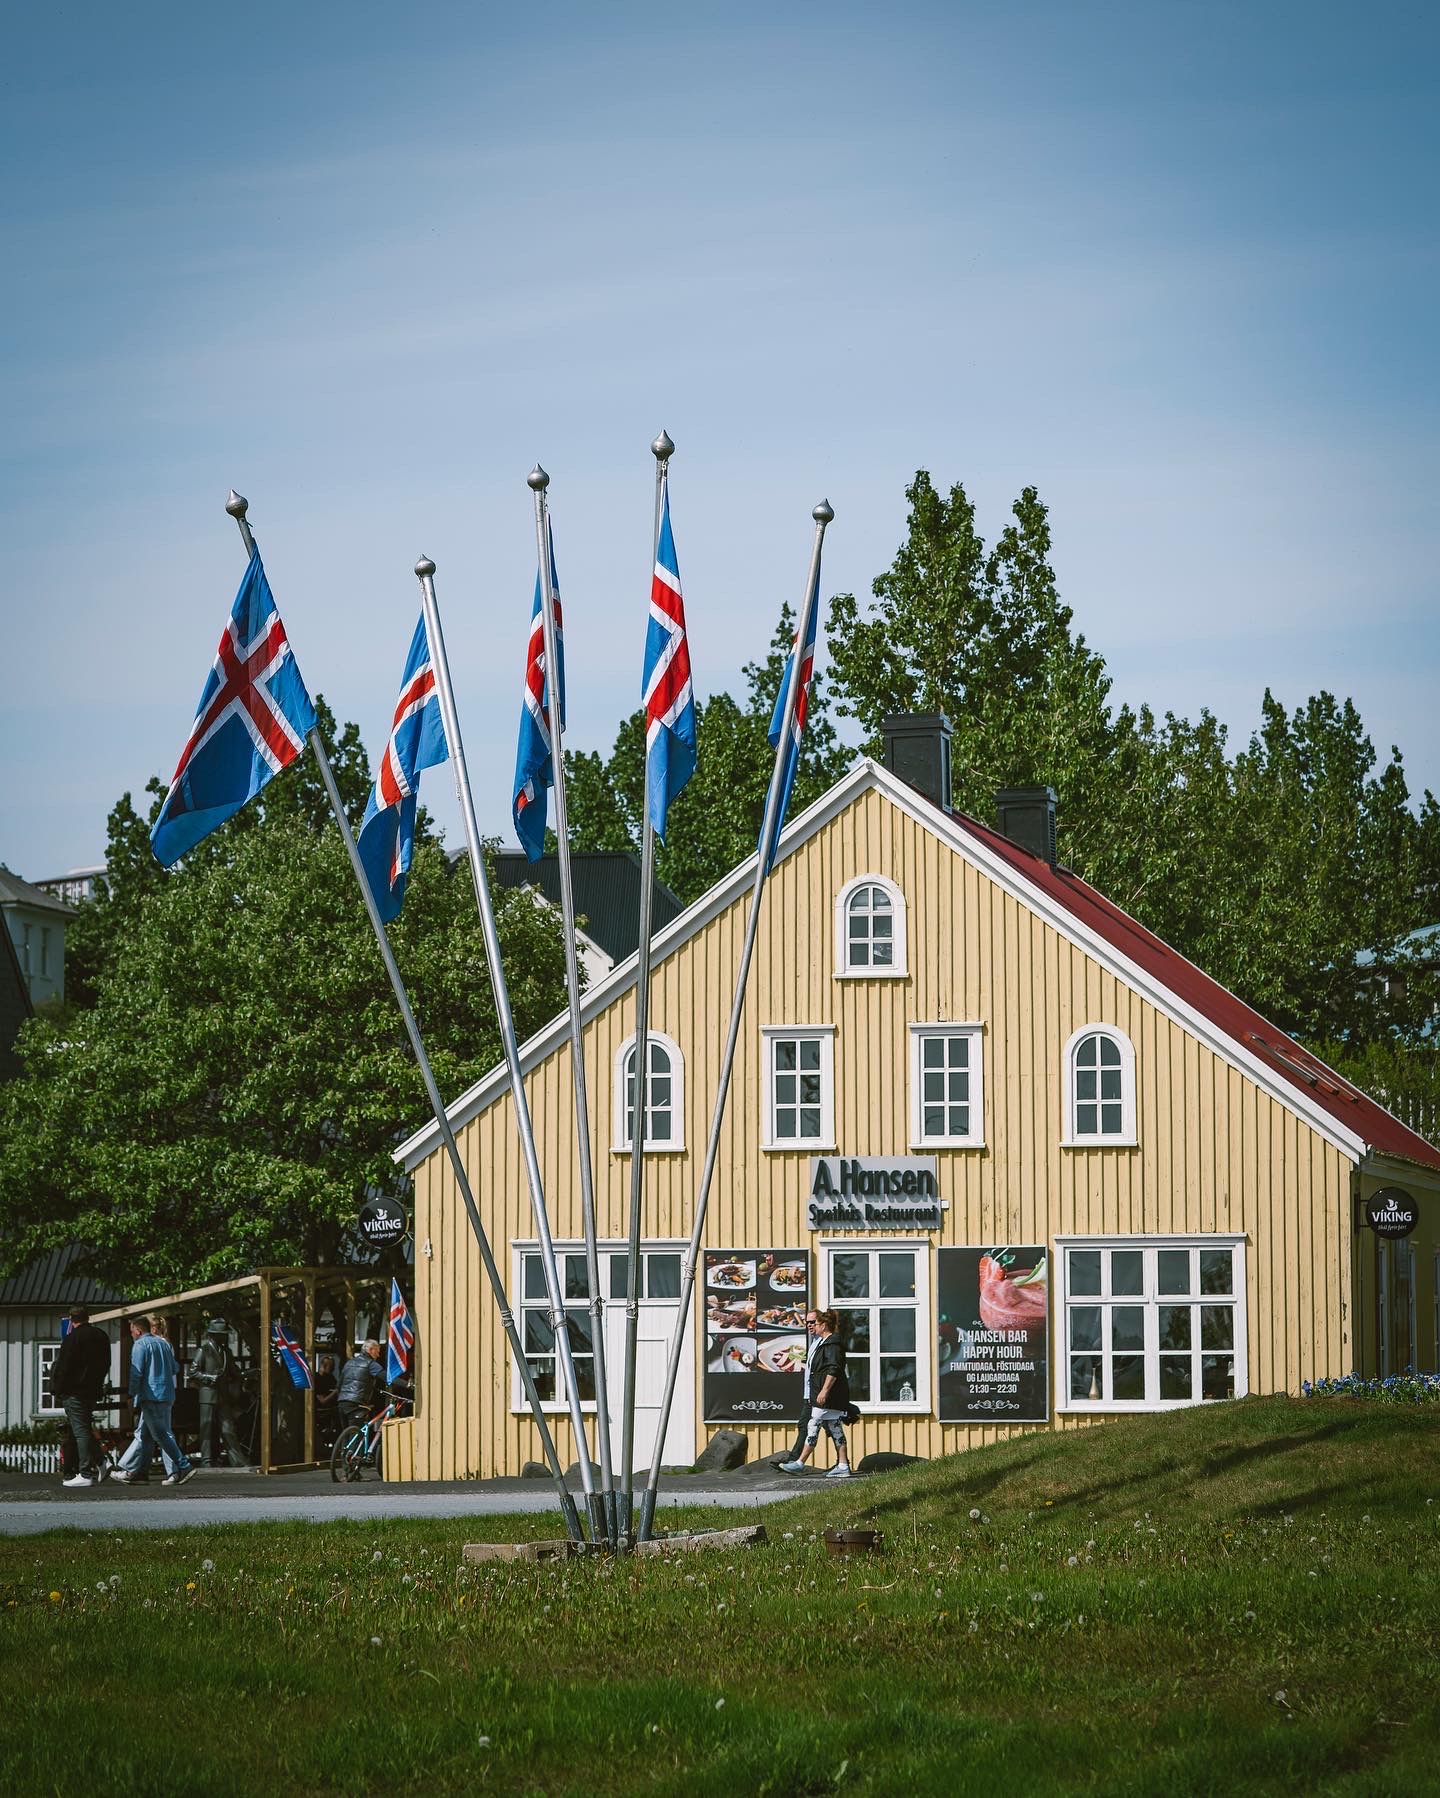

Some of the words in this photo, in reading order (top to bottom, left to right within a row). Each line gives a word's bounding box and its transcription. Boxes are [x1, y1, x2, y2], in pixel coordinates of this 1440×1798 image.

[865, 1204, 938, 1222] Restaurant
[1371, 1209, 1412, 1222] VÍKING
[363, 1218, 402, 1232] VÍKING
[420, 1238, 432, 1257] 4
[1007, 1330, 1028, 1343] BAR
[963, 1346, 994, 1359] HAPPY
[996, 1346, 1023, 1359] HOUR
[996, 1360, 1035, 1371] FÖSTUDAGA
[966, 1372, 976, 1382] OG
[976, 1372, 1020, 1382] LAUGARDAGA
